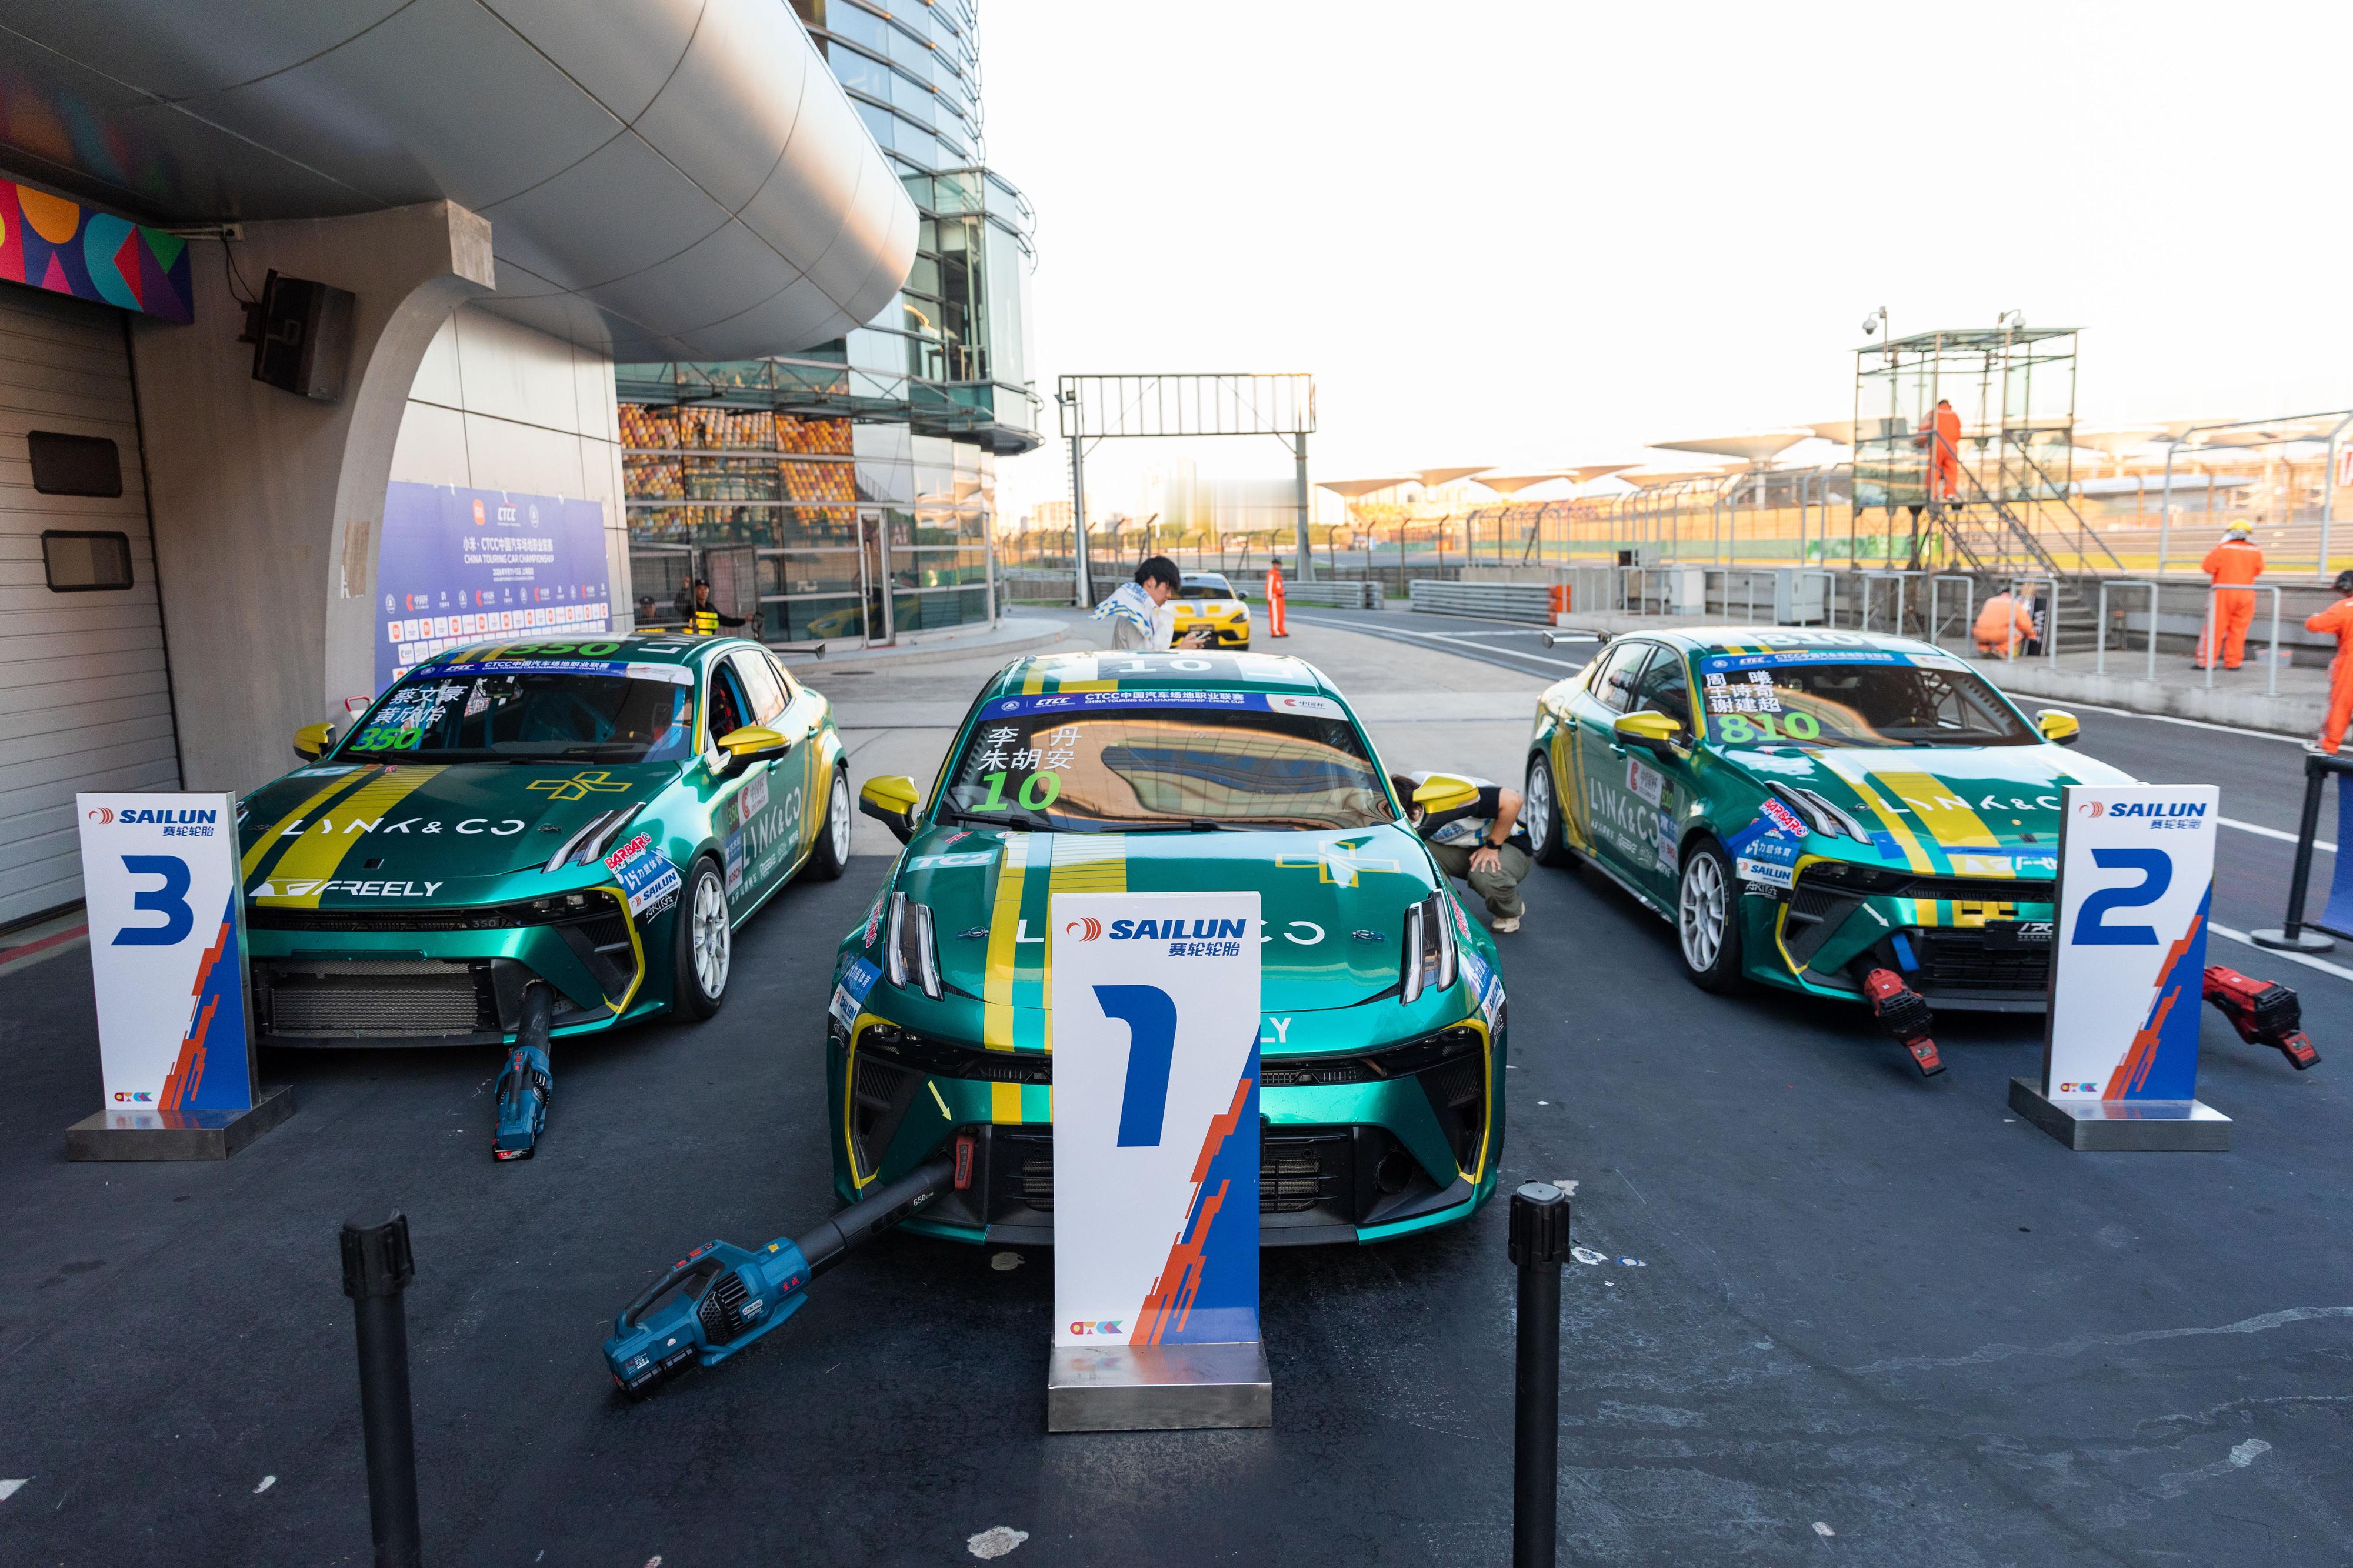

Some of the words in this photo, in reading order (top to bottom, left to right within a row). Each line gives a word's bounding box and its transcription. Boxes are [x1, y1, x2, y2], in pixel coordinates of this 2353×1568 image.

[464, 554, 483, 564] CHINA
[483, 554, 507, 564] TOURING
[507, 554, 518, 563] CAR
[519, 554, 555, 564] CHAMPIONSHIP
[502, 642, 621, 656] 350
[1120, 659, 1212, 673] 10
[389, 685, 468, 705] 蔡文豪
[1036, 697, 1071, 706] CTCC
[1085, 691, 1245, 701] CTCC中国汽车场地职业联赛
[1711, 697, 1782, 713] 谢建超
[370, 705, 446, 725] 黄欣怡
[1718, 712, 1821, 743] 810
[349, 727, 422, 752] 350
[977, 748, 1075, 772] 朱胡安
[971, 770, 1062, 812] 10
[1878, 795, 2061, 814] LYNK&C
[2109, 802, 2208, 817] SAILUN
[119, 809, 217, 824] SAILUN
[1764, 798, 1810, 838] BARBARO
[2150, 820, 2202, 829] 赛轮轮胎
[162, 826, 214, 837] 赛轮轮胎
[604, 832, 652, 870] BARBARO
[1759, 843, 1792, 858] 力盛体育
[637, 855, 664, 879] 力盛体育
[916, 853, 993, 868] TC2
[1751, 865, 1791, 880] SAILUN
[311, 880, 444, 898] FREELY
[643, 872, 677, 902] SAILUN
[111, 855, 194, 946] 3
[2071, 848, 2173, 945] 2
[472, 919, 496, 928] 350
[1109, 919, 1247, 940] SAILUN
[1168, 942, 1241, 957] 赛轮轮胎
[839, 995, 858, 1022] SAILUN
[1092, 985, 1177, 1147] 1
